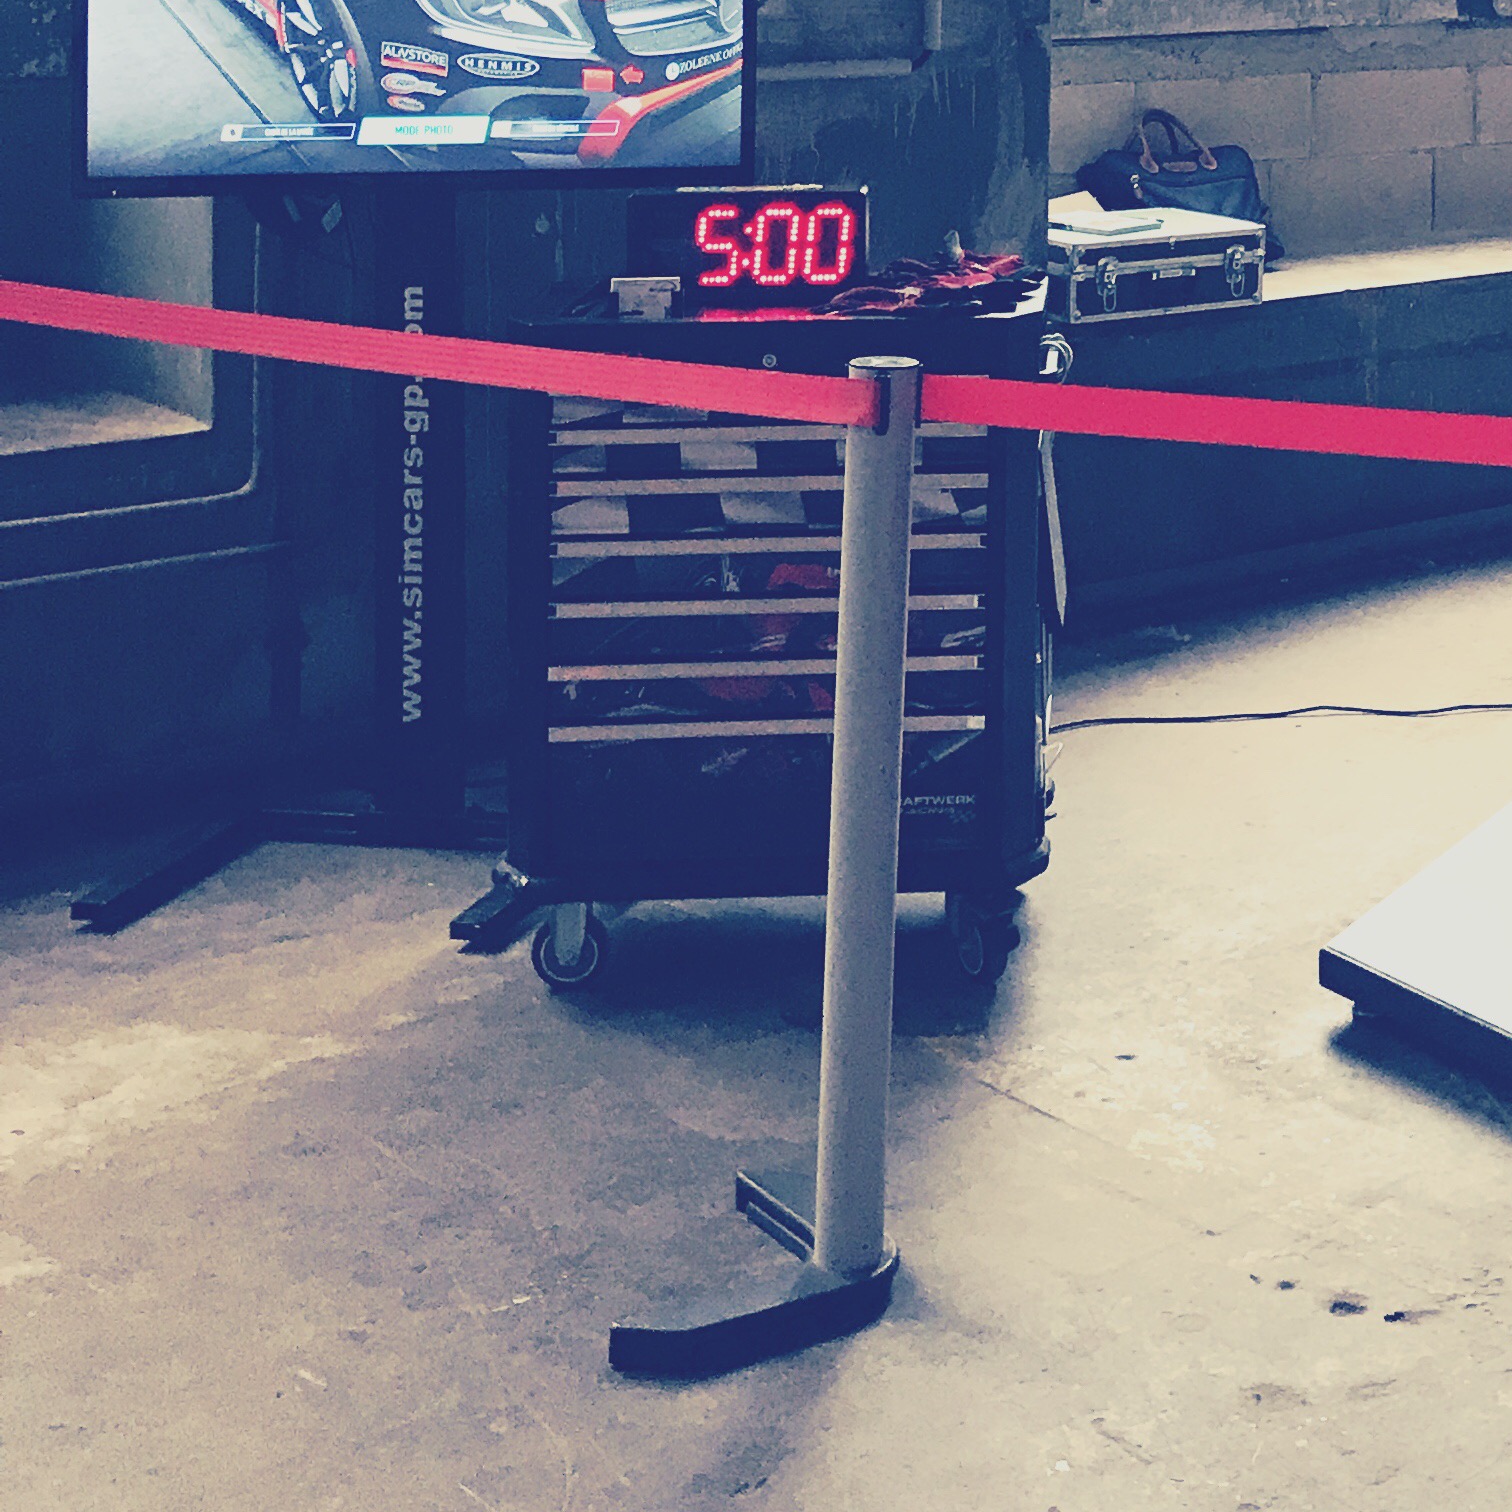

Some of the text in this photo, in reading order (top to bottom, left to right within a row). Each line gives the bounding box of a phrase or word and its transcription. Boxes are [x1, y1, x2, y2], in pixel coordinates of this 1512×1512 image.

[395, 125, 454, 136] MODE PHOTO
[696, 203, 855, 286] 5:00
[398, 286, 429, 723] www.simcars-gp.om
[899, 794, 976, 807] AFTWERK
